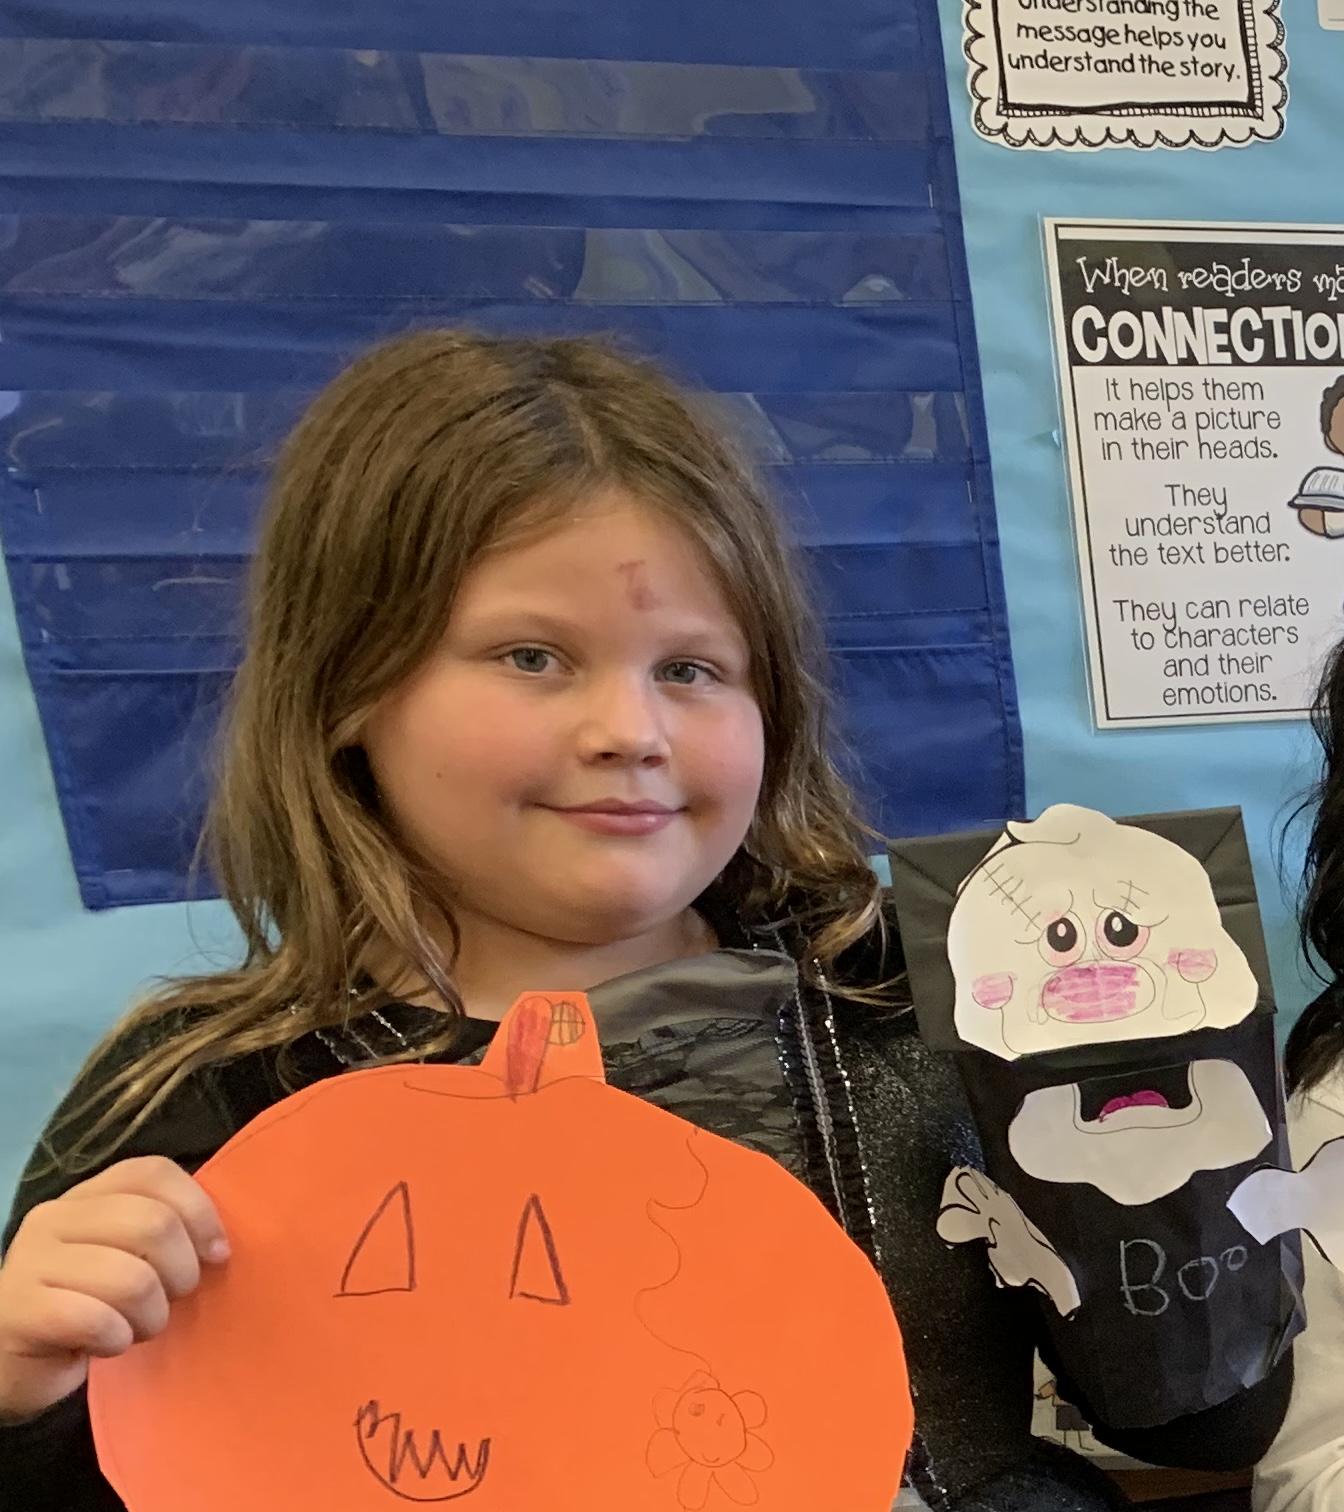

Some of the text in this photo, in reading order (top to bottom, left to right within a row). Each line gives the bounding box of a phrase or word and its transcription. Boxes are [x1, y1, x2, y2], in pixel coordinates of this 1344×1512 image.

[1017, 22, 1226, 51] message helps you
[1007, 49, 1241, 82] understand the story.
[1076, 256, 1168, 295] When
[1178, 258, 1302, 297] readers
[1105, 378, 1264, 411] It helps them
[1094, 409, 1281, 440] make a picture
[1102, 437, 1279, 461] in their heads.
[1165, 484, 1228, 516] They
[1126, 512, 1271, 537] understand
[1108, 542, 1290, 567] the text better.
[1112, 595, 1309, 632] They can relate
[1131, 624, 1299, 650] to characters
[1164, 653, 1272, 677] and their
[1163, 682, 1277, 706] emotions.
[1119, 1239, 1248, 1316] Boo
